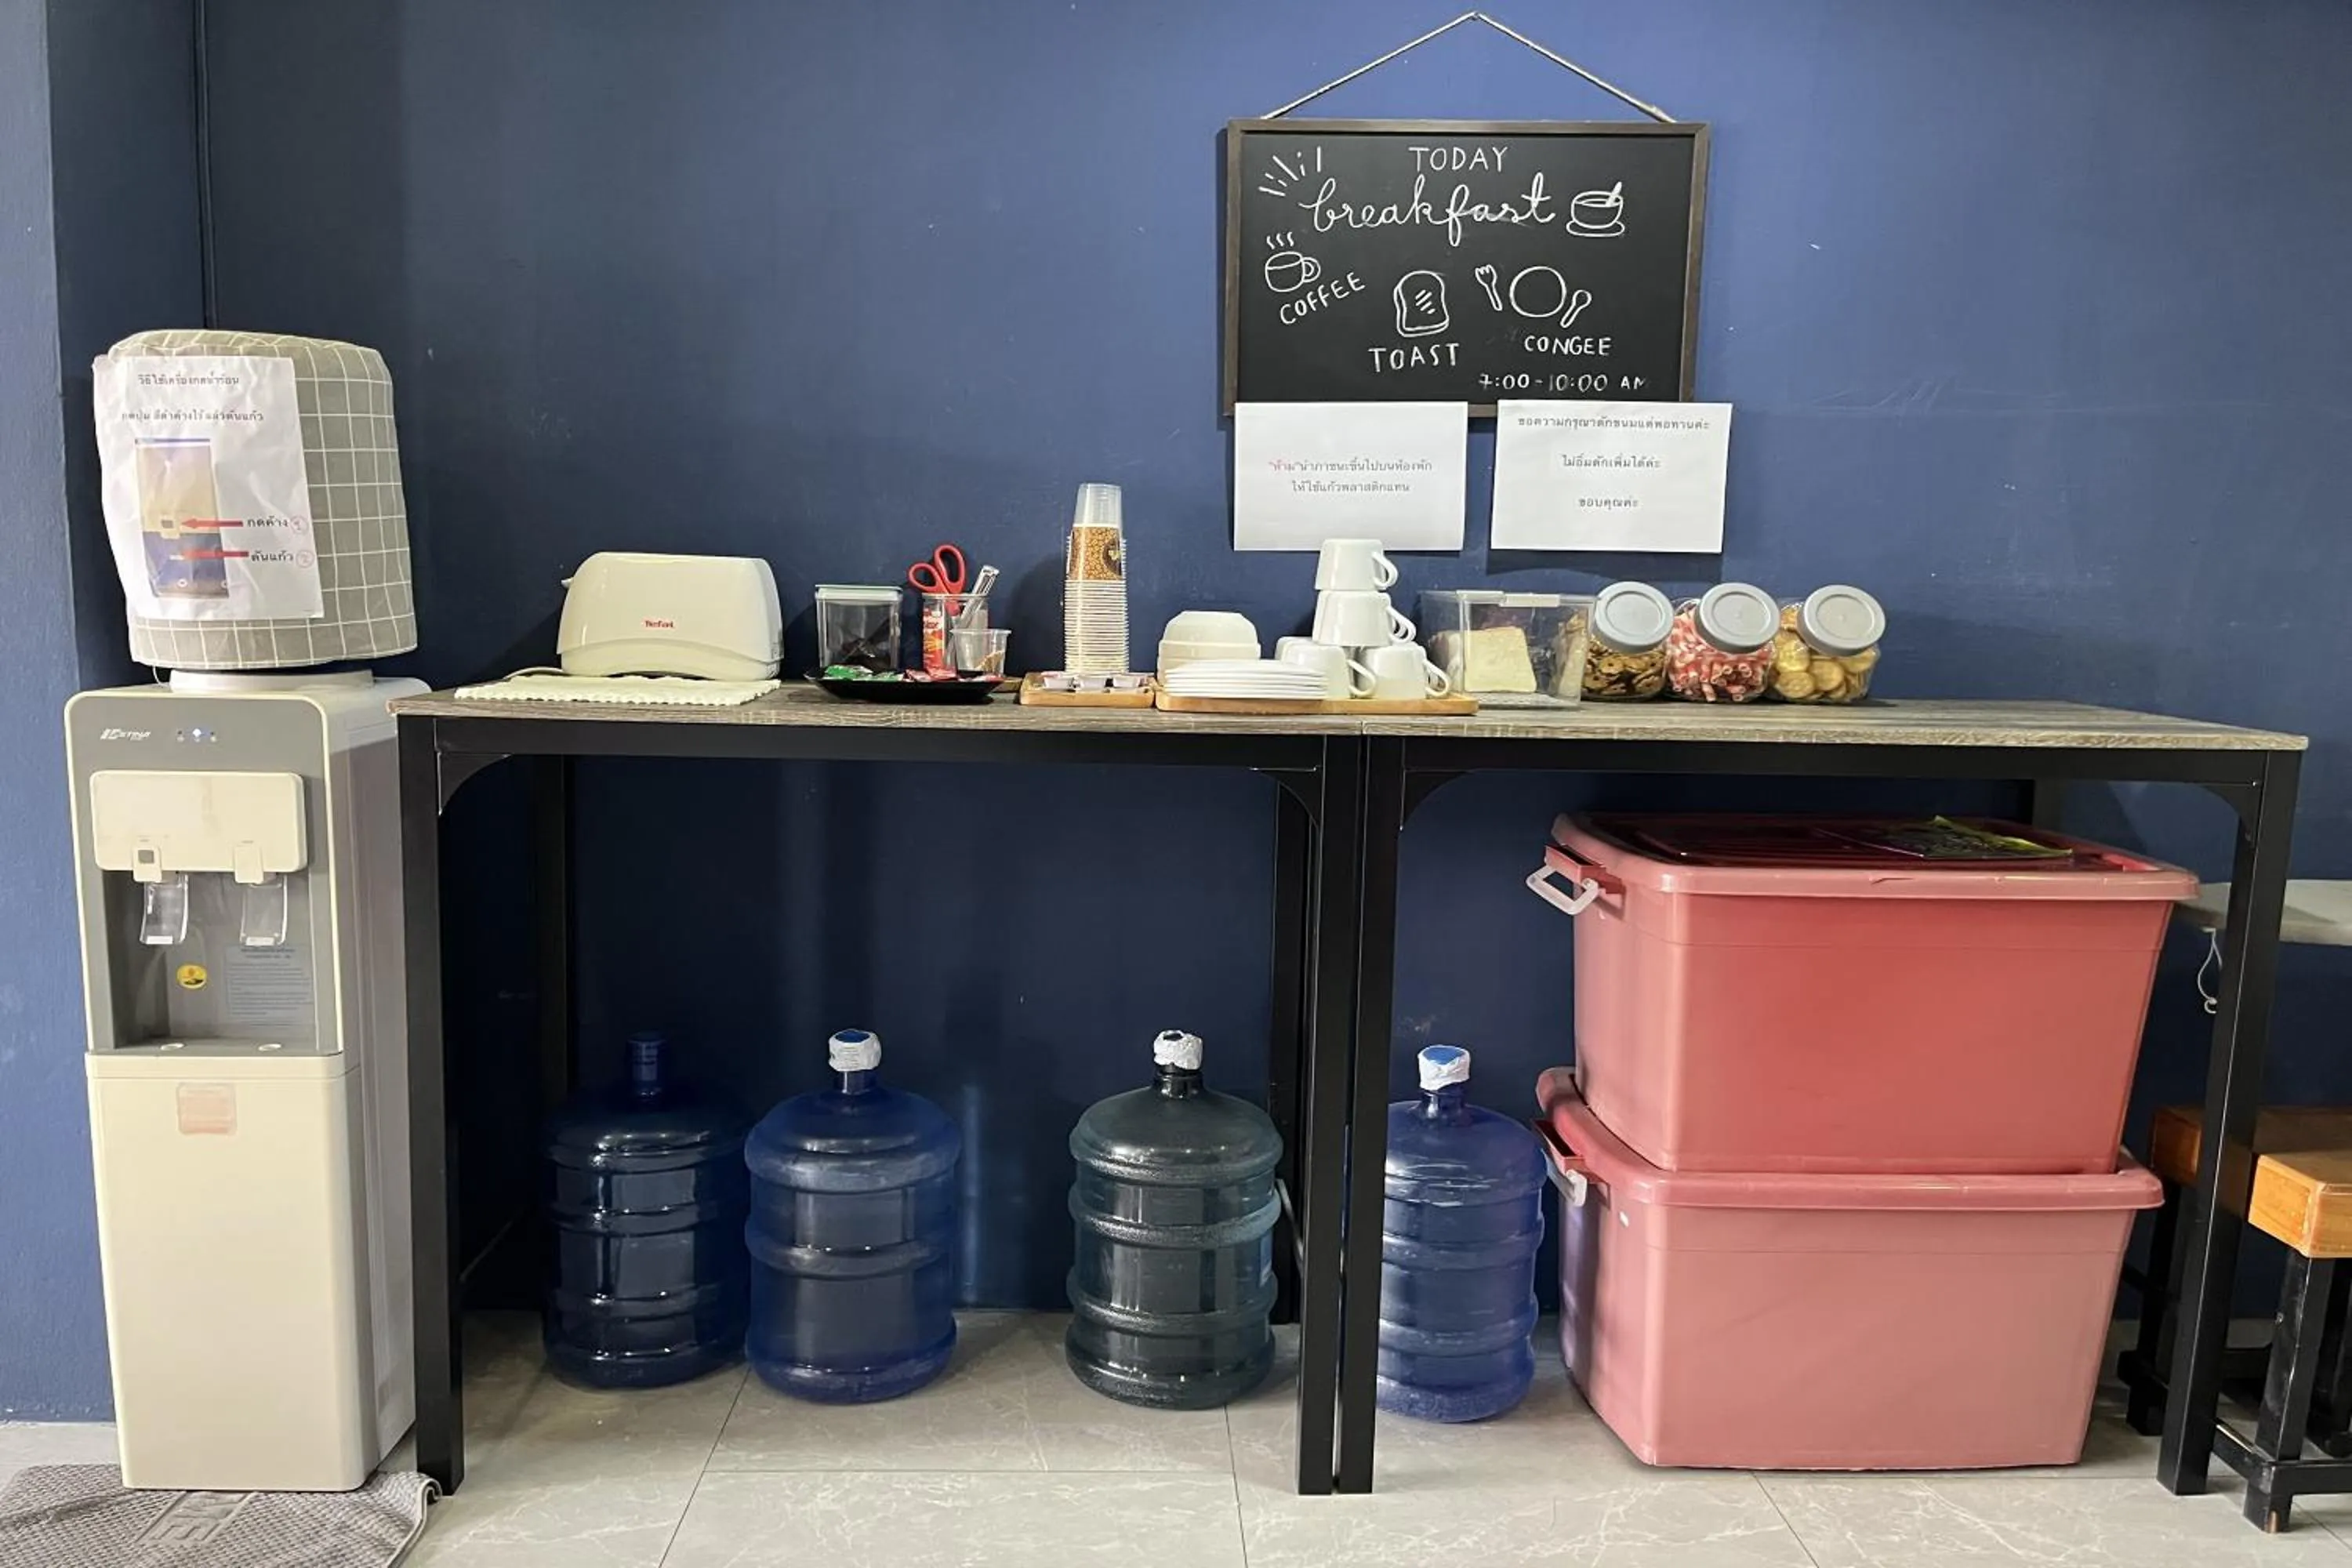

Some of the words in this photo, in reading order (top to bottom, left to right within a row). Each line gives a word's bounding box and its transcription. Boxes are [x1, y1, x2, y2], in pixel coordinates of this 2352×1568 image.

[1408, 146, 1509, 172] TODAY
[1298, 172, 1556, 247] breakfast
[1279, 271, 1366, 325] COFFEE
[1367, 342, 1460, 373] TOAST
[1523, 335, 1613, 357] CONGEE
[247, 515, 289, 528] กดค้าง
